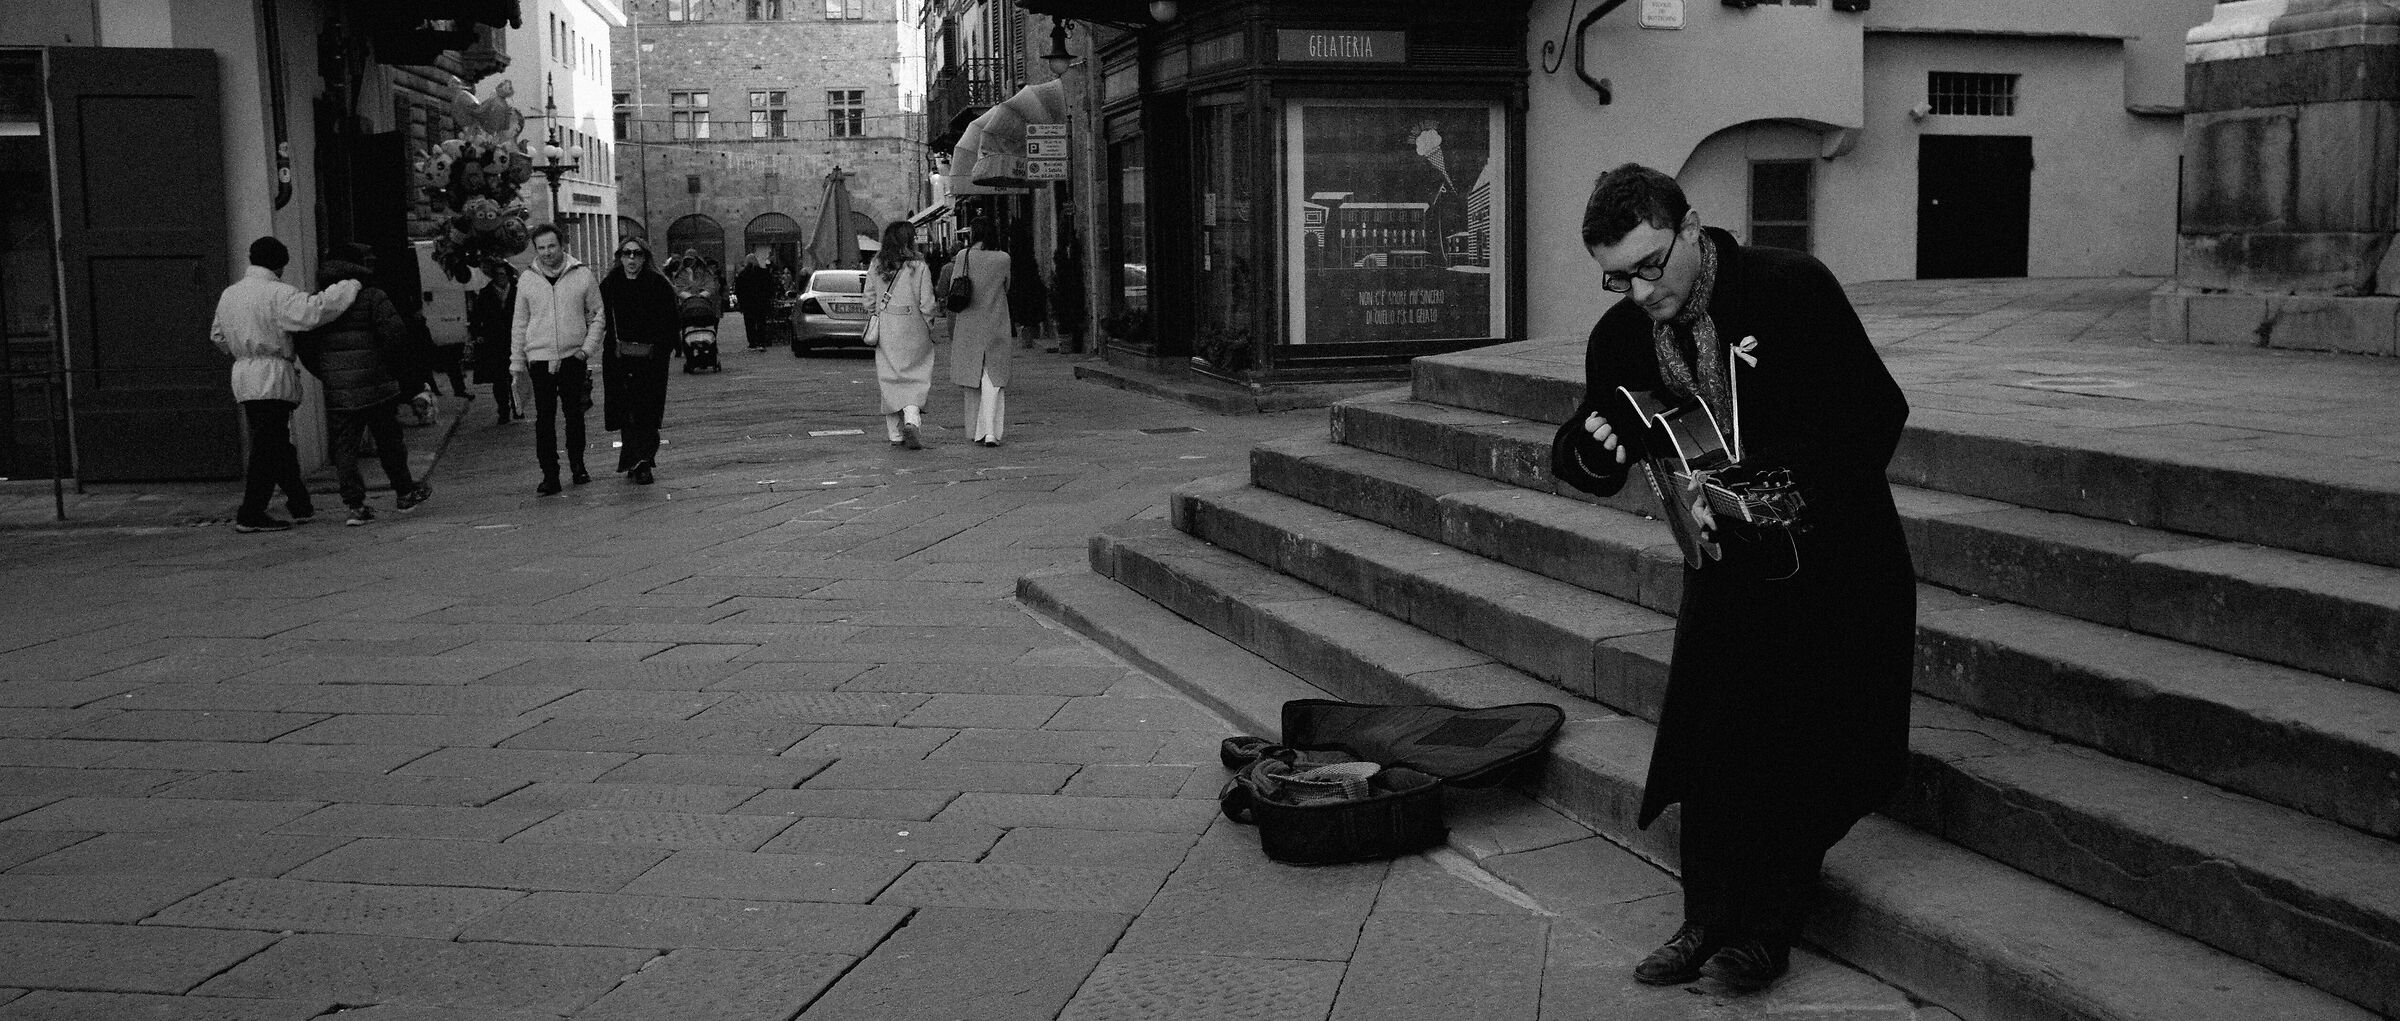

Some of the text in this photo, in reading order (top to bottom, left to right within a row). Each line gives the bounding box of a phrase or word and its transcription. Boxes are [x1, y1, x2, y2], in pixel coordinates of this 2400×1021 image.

[1309, 35, 1373, 58] GELATERIA
[1359, 291, 1373, 306] NON
[1388, 290, 1407, 305] AMORE
[1420, 289, 1444, 304] SINCERO
[1366, 310, 1373, 325] DI
[1374, 309, 1395, 325] QUELLO
[1416, 308, 1438, 323] GELATO
